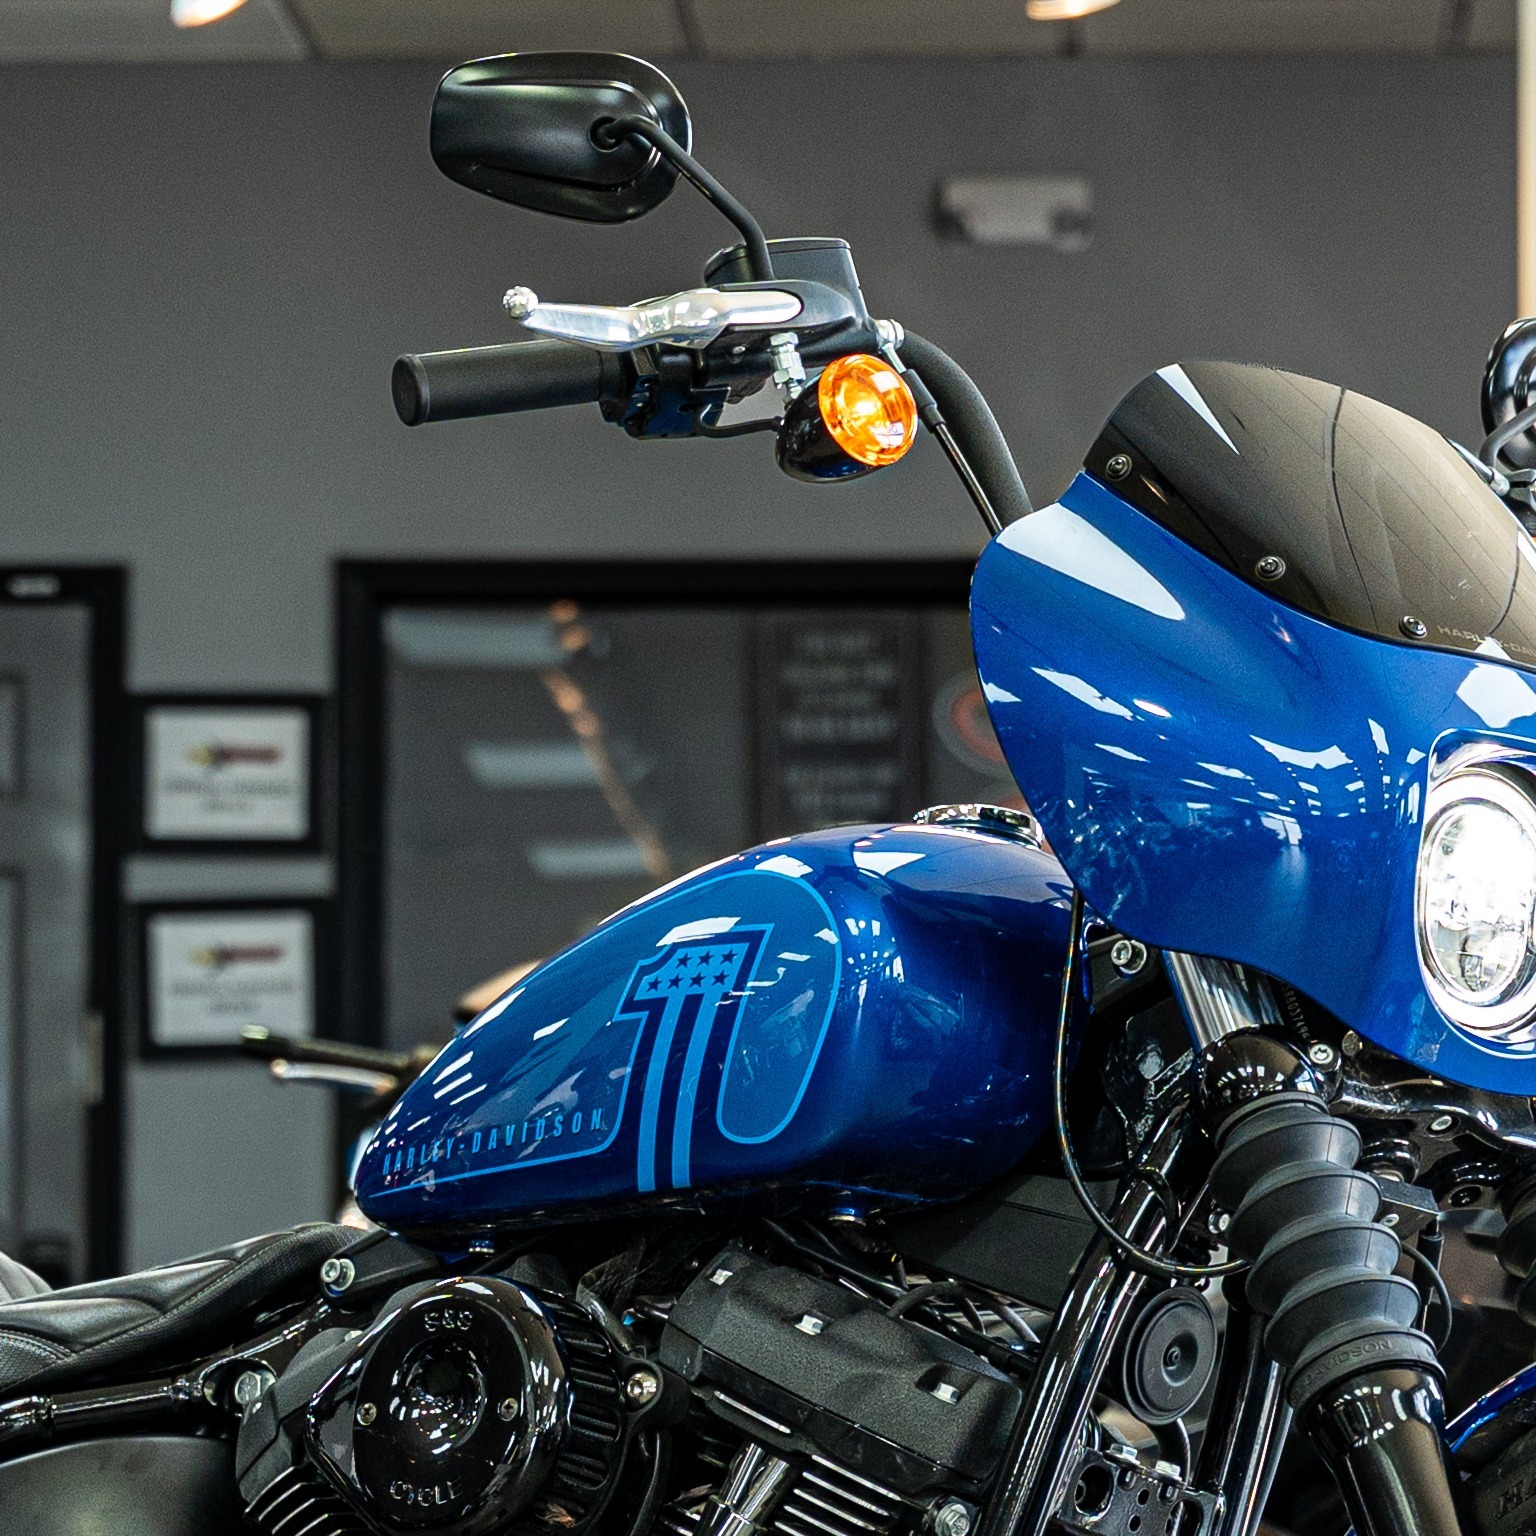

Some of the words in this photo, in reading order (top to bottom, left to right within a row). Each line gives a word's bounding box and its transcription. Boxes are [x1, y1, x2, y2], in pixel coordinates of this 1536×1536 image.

[381, 1108, 605, 1177] HARLEY-DAVIDSON
[423, 1308, 474, 1332] S&S
[389, 1475, 463, 1507] CYCLE
